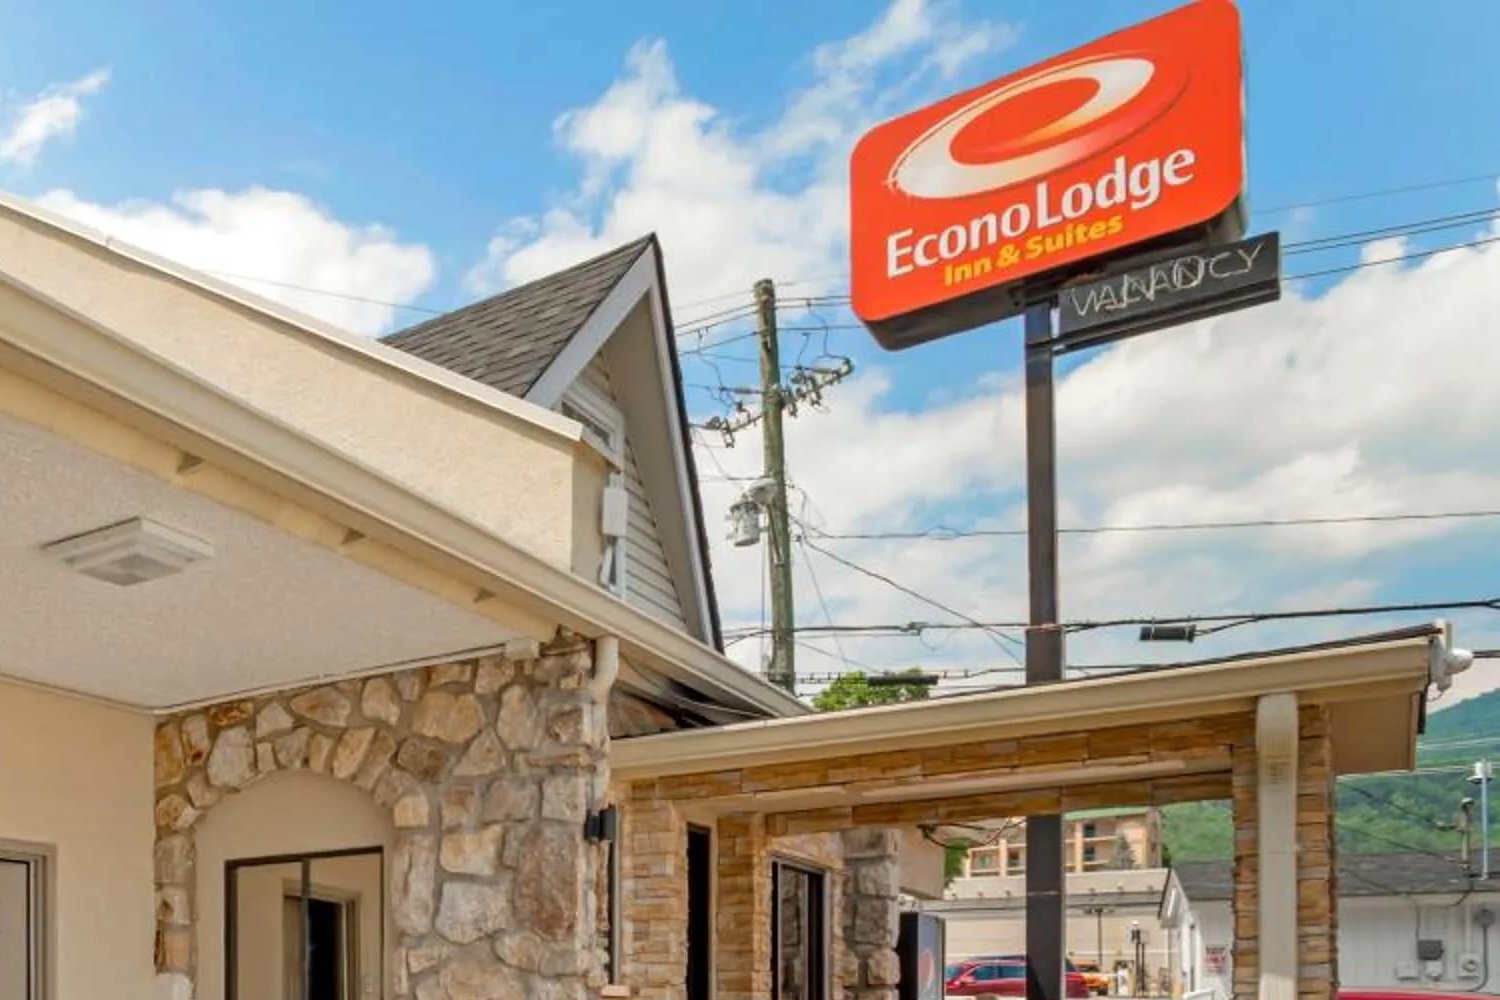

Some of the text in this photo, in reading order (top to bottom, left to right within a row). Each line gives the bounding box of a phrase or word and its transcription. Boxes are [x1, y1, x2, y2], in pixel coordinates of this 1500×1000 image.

[944, 214, 1123, 286] Inn & Suites
